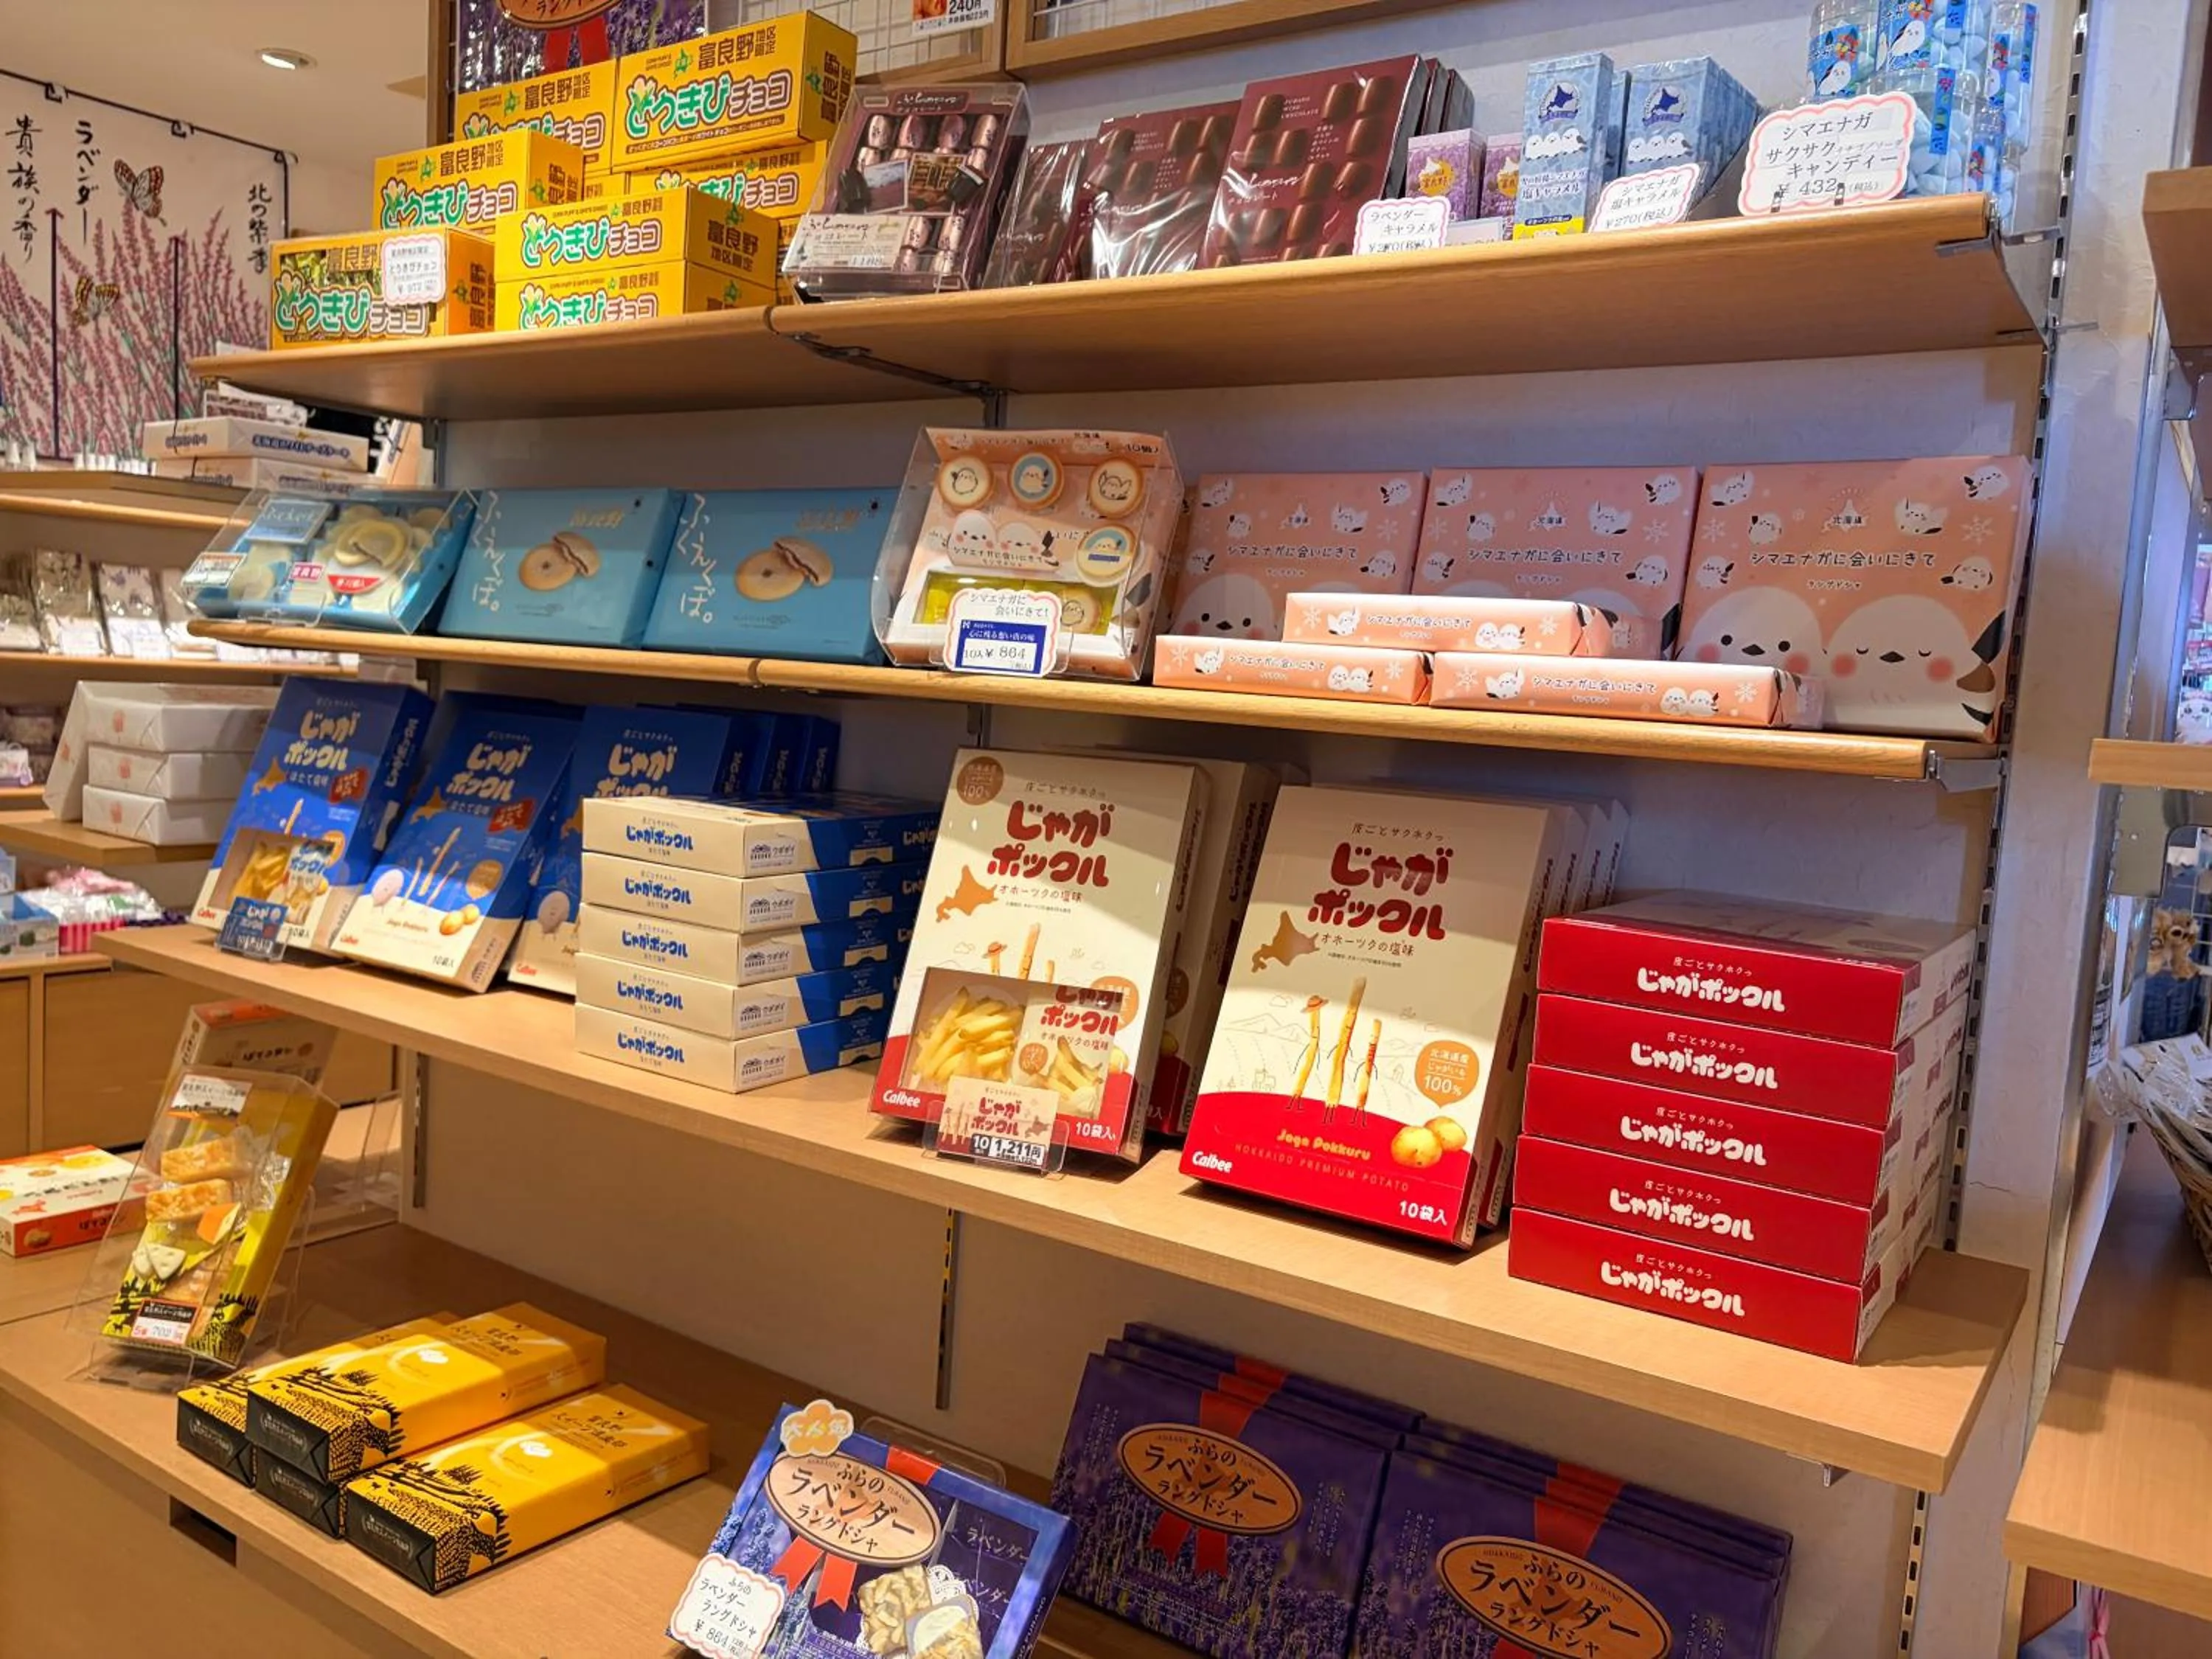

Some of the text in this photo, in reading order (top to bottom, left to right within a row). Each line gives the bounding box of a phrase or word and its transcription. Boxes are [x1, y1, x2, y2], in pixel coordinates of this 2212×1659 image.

[698, 32, 755, 71] 富良野
[524, 76, 572, 111] 富良野
[627, 69, 793, 139] とうきびチョコ
[1782, 112, 1874, 141] シマエナガ
[440, 145, 485, 177] 富良野
[1767, 141, 1835, 164] サクサク
[1787, 153, 1899, 178] キャンディー
[5, 114, 43, 263] 貴族の香り
[75, 120, 101, 246] ラベンダー
[1621, 175, 1680, 196] シマエナガ
[1799, 178, 1835, 197] 432
[381, 178, 520, 232] とうきびチョコ
[1371, 209, 1425, 222] ラベンダー
[523, 213, 661, 268] とうきびチョコ
[708, 220, 759, 257] 富良野
[1383, 223, 1439, 235] キャラメル
[276, 288, 427, 333] とうきびチョコ
[1227, 544, 1357, 560] シマエナガに会いにきて
[1467, 548, 1624, 565] シマエナガに会いにきて
[1750, 551, 1938, 568] シマエナガに会いにきて
[970, 594, 1027, 605] シマエナガに
[1530, 675, 1658, 695] シマエナガに会いにきて
[300, 710, 361, 743] じゃが
[284, 740, 349, 771] ポックル
[466, 742, 532, 775] じゃが
[608, 742, 678, 782] じゃが
[445, 770, 516, 802] ポックル
[626, 824, 694, 851] じゃがポックル
[1007, 800, 1116, 848] じゃが
[1351, 822, 1444, 842] 皮ごとサクホクっ
[987, 842, 1110, 888] ポックル
[1330, 842, 1453, 896] じゃが
[624, 877, 692, 905] じゃがポックル
[998, 885, 1083, 903] オホーツクの塩味
[1307, 888, 1446, 941] ポックル
[621, 930, 689, 959] じゃがポックル
[1321, 933, 1415, 957] オホーツクの塩味
[1672, 956, 1753, 978] 皮ごとサクホクっ
[616, 982, 684, 1011] じゃがポックル
[1637, 967, 1786, 1013] じゃがポックル
[1040, 1004, 1120, 1037] ポックル
[616, 1032, 685, 1064] じゃがポックル
[1428, 1048, 1470, 1065] 北海道産
[1666, 1032, 1746, 1054] 皮ごとサクホクっ
[1630, 1042, 1778, 1091] じゃがポックル
[883, 1089, 922, 1107] Calbee
[1422, 1074, 1463, 1097] 100%
[978, 1097, 1023, 1120] じゃが
[1655, 1106, 1734, 1131] 皮ごとサクホクっ
[970, 1116, 1020, 1136] ポックル
[1076, 1121, 1116, 1140] 10袋入
[1620, 1116, 1767, 1167] じゃがポックル
[1276, 1128, 1372, 1162] Jaga Pokkuru
[1191, 1150, 1234, 1175] Calbee
[1234, 1142, 1411, 1194] HOKKAIDO PREMIUM POTATO
[1644, 1180, 1722, 1205] 皮ごとサクホクっ
[1399, 1200, 1449, 1228] 10袋入
[1608, 1187, 1756, 1242] じゃがポックル
[1635, 1253, 1713, 1280] 皮ごとサクホクっ
[1601, 1259, 1746, 1318] じゃがポックル
[1187, 1438, 1237, 1467] ふらの
[837, 1464, 886, 1494] ふらの
[1144, 1444, 1279, 1506] ラベンダー
[785, 1467, 917, 1535] ラベンダー
[1157, 1480, 1245, 1526] ラングドシャ
[796, 1503, 880, 1553] ラングドシャ
[967, 1526, 1030, 1561] ラベンダー
[1523, 1555, 1587, 1590] ふらの
[700, 1578, 745, 1607] ラベンダー
[1469, 1559, 1641, 1639] ラベンダー
[701, 1599, 757, 1638] ラングドシャ
[1489, 1601, 1600, 1658] ラングドシャ
